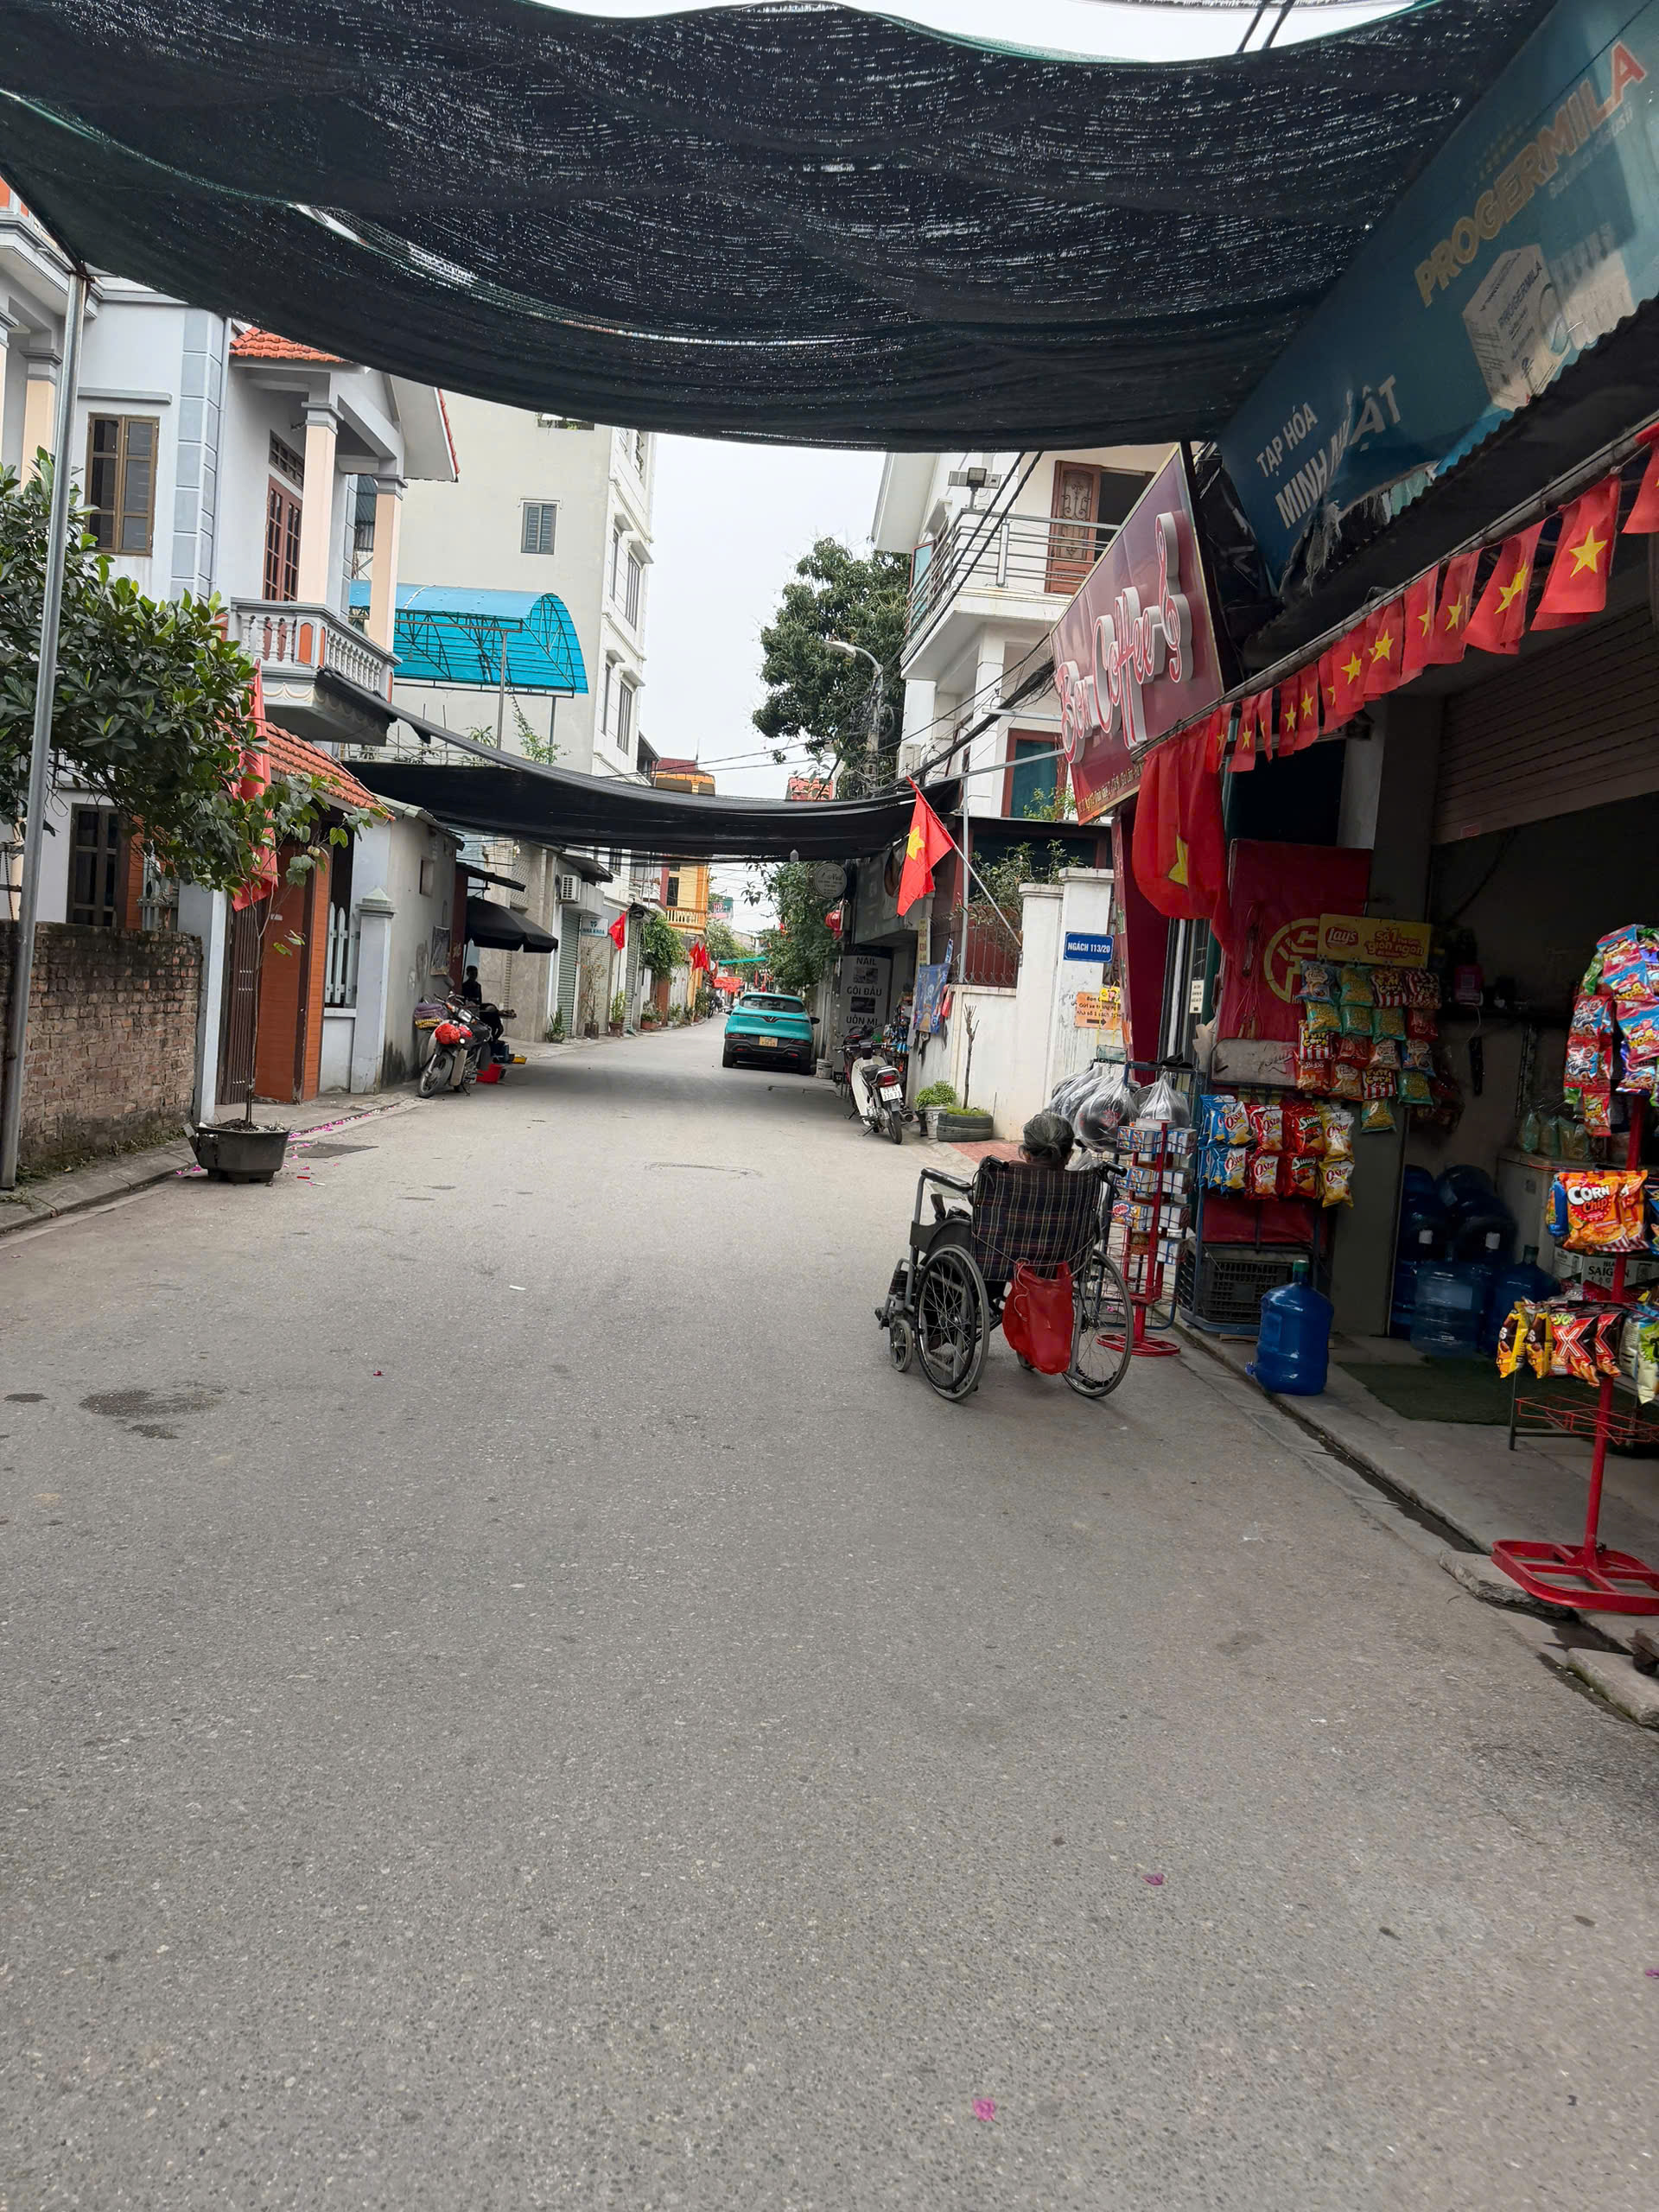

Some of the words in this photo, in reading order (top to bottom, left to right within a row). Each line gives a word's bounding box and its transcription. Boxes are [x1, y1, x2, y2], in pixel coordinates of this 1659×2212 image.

[1414, 41, 1647, 308] PROGERMILA
[1255, 435, 1283, 478] TẠP
[1282, 401, 1319, 450] HÓA
[1274, 448, 1328, 530] MINH
[1056, 660, 1096, 764] Ben
[1092, 586, 1165, 750] Coffee
[1067, 941, 1089, 952] NGÁCH
[1090, 944, 1111, 954] 113/20
[856, 957, 877, 966] NAIL
[1567, 1185, 1611, 1206] CORN
[1582, 1197, 1609, 1214] Chip
[1588, 1265, 1630, 1278] SAIG
